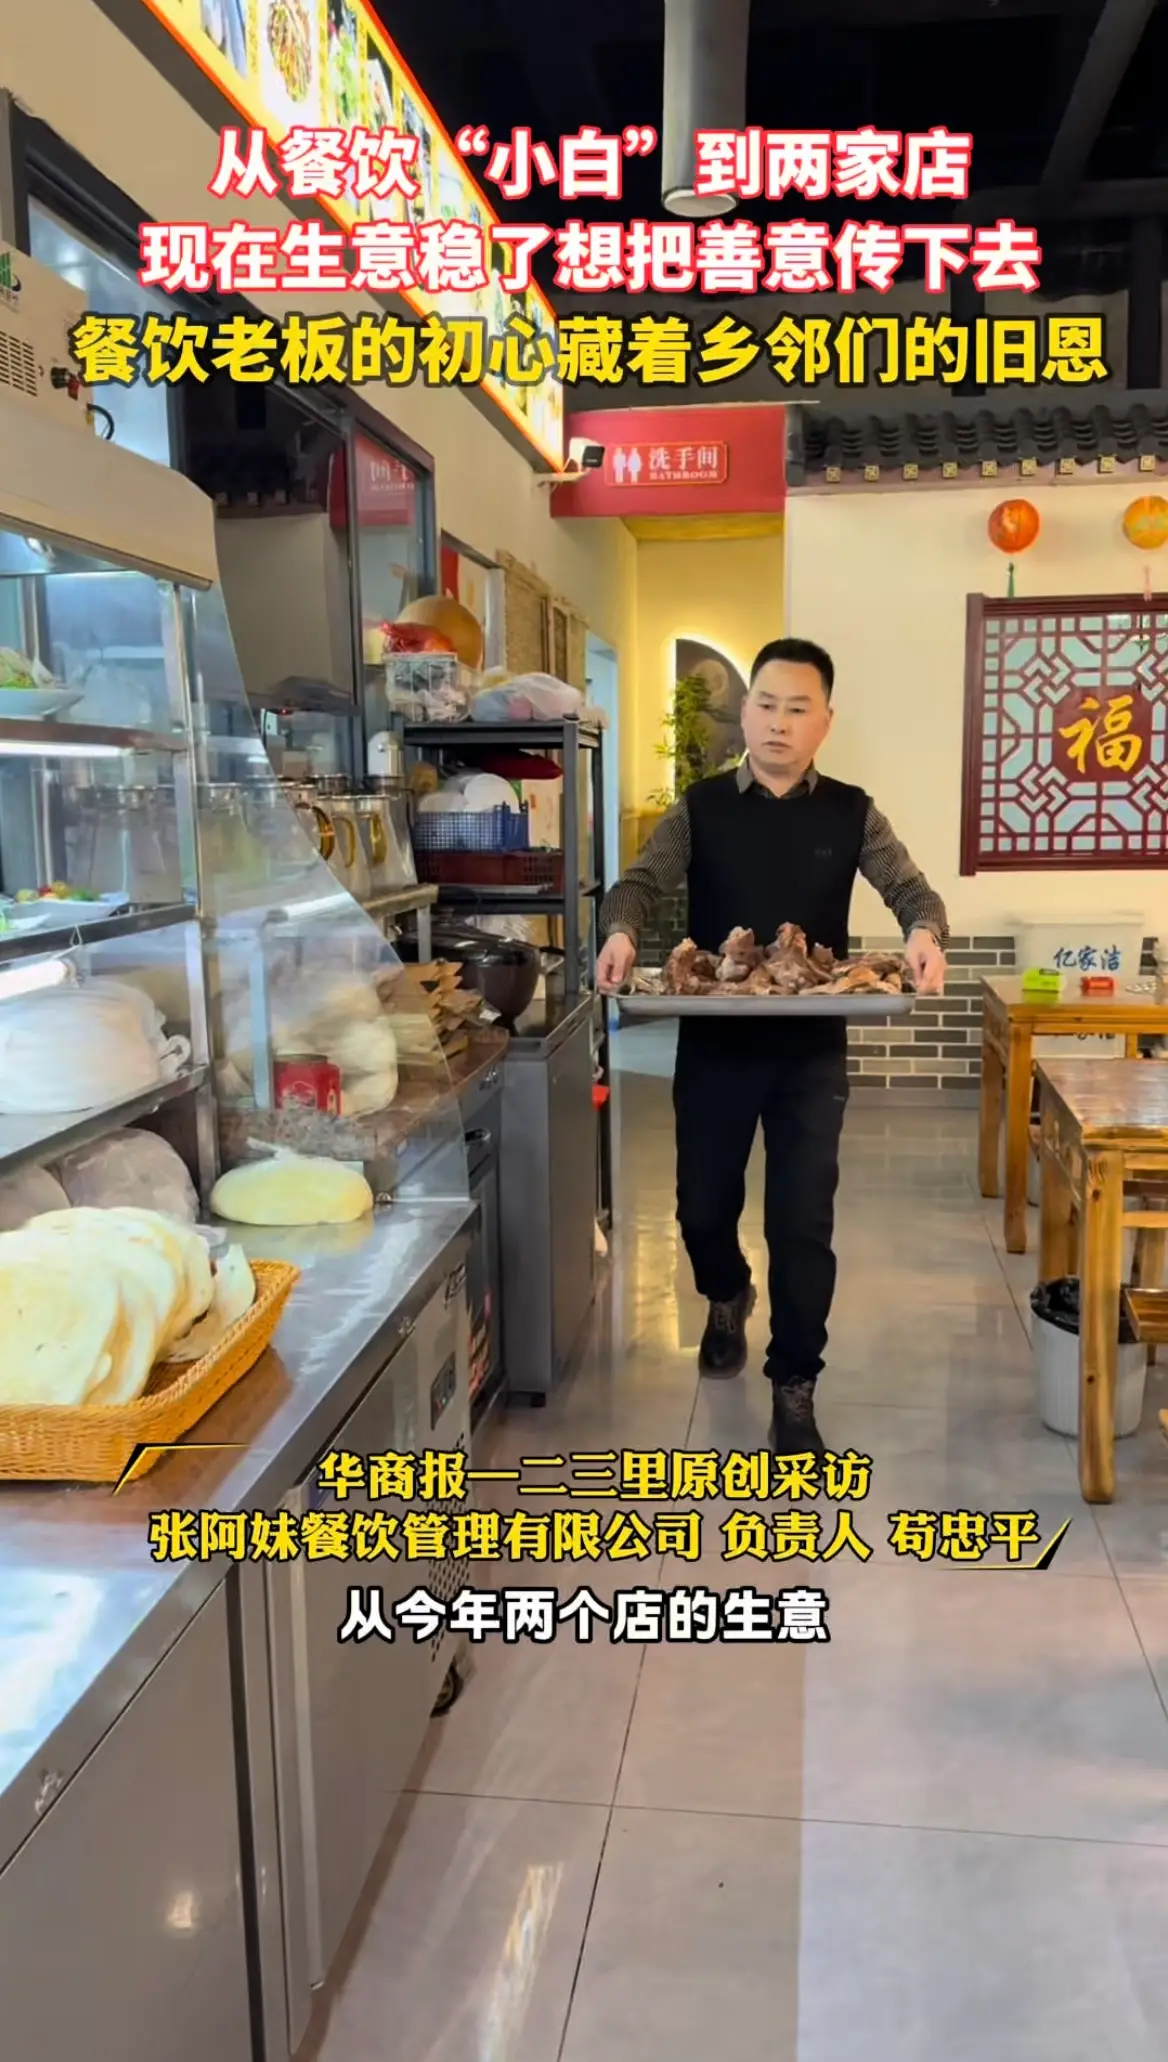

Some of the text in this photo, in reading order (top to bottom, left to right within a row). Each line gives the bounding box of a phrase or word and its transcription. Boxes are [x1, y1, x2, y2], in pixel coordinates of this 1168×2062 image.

[648, 445, 718, 470] 洗手间
[1058, 695, 1143, 774] 福
[1053, 945, 1121, 972] 亿家洁
